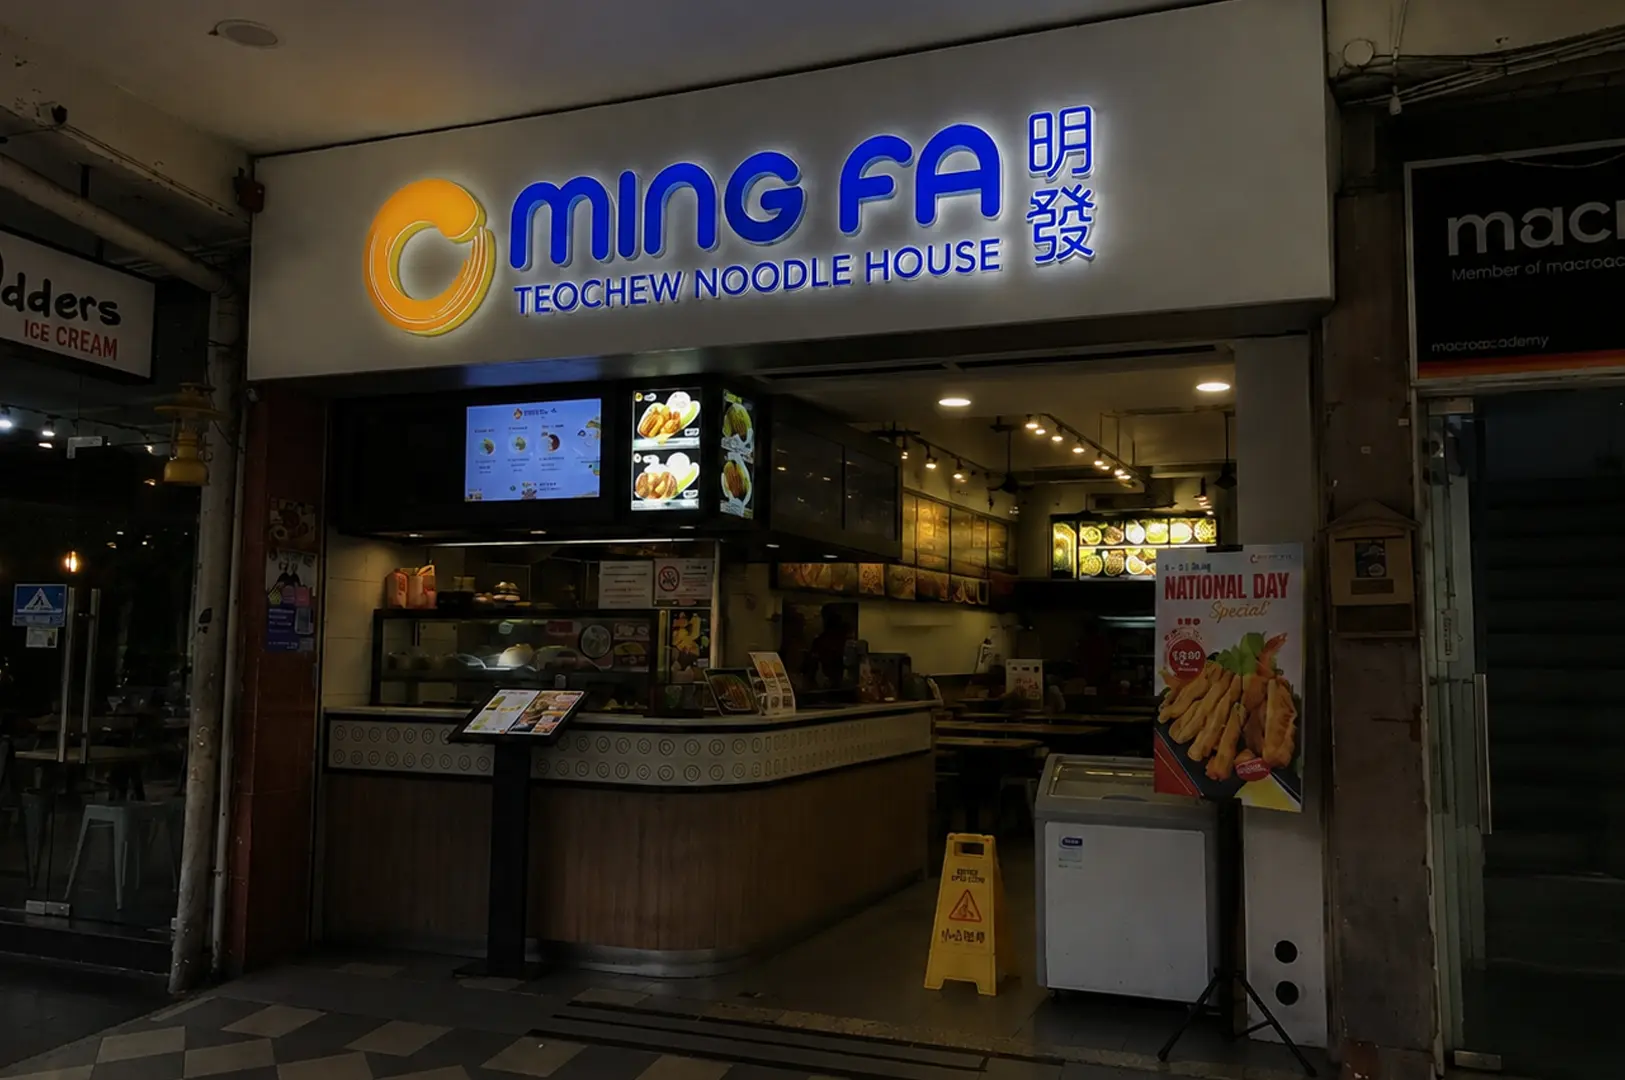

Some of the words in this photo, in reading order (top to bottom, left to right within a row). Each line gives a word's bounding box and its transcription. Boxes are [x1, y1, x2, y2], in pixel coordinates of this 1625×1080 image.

[839, 123, 1003, 236] FA
[1026, 104, 1096, 264] 明發
[0, 252, 121, 326] dders
[513, 270, 684, 316] TEOCHEW
[694, 254, 853, 300] NOODLE
[865, 237, 1003, 284] HOUSE
[1452, 263, 1522, 283] Member
[1525, 259, 1541, 275] of
[24, 319, 50, 342] ICE
[56, 326, 118, 361] CREAM
[1164, 574, 1247, 600] NATIONAL
[1252, 572, 1290, 599] DAY
[1208, 600, 1271, 623] Special
